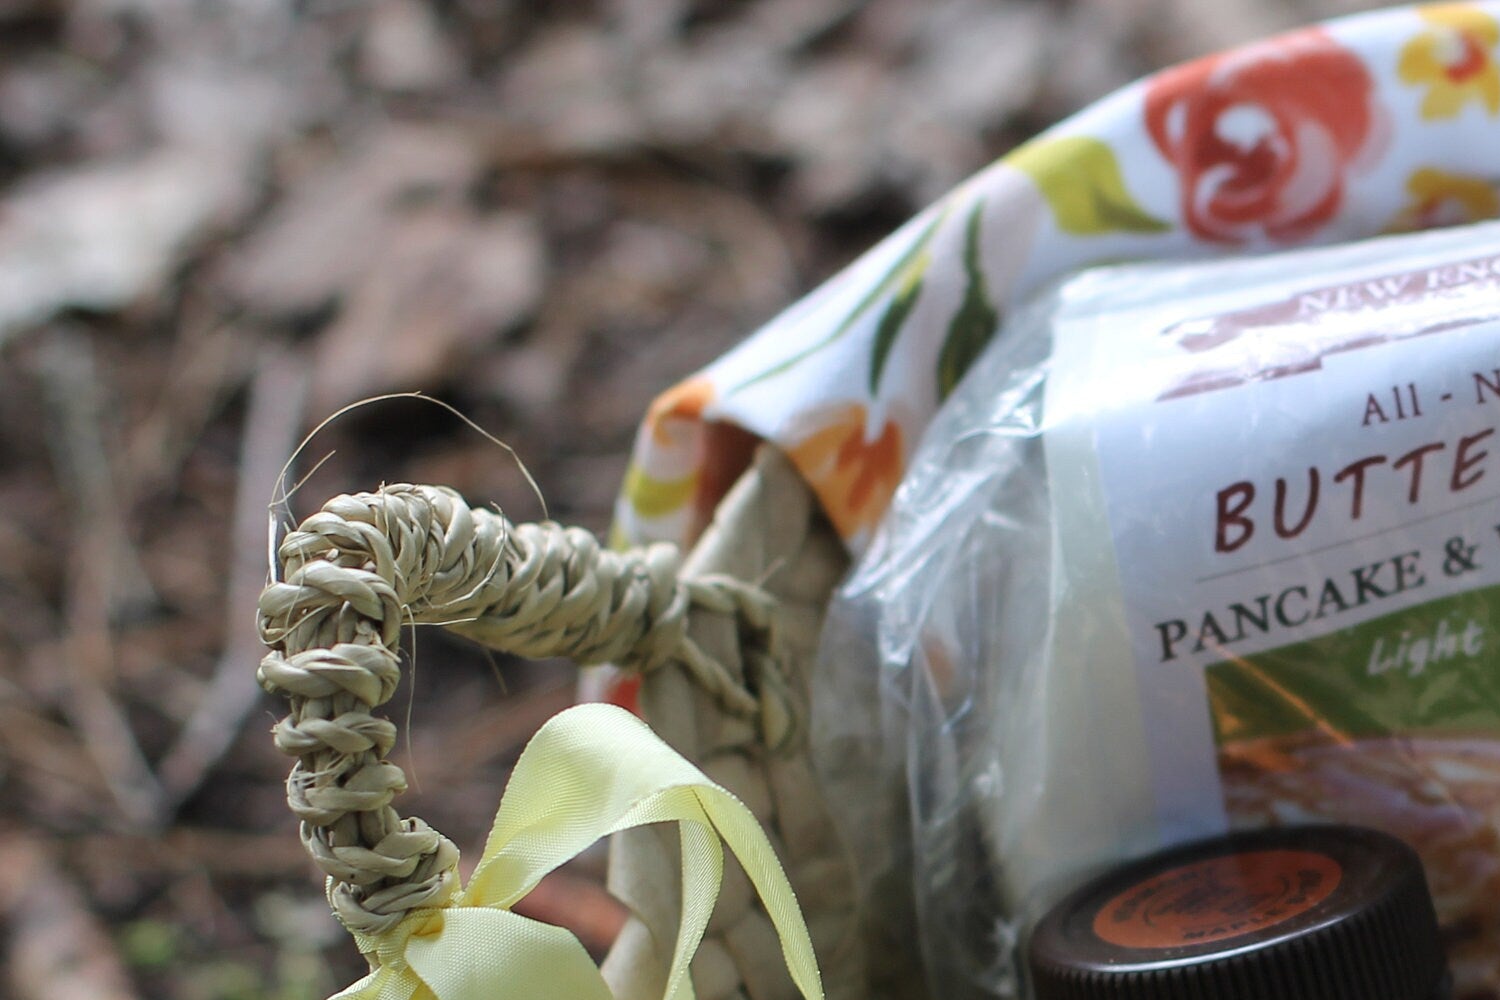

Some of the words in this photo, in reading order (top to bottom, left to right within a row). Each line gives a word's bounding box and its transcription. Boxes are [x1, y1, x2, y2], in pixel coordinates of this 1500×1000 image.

[1299, 275, 1411, 314] NEW
[1361, 383, 1423, 427] All
[1155, 550, 1428, 663] PANCAKE
[1442, 536, 1482, 579] &
[1367, 614, 1484, 677] Light
